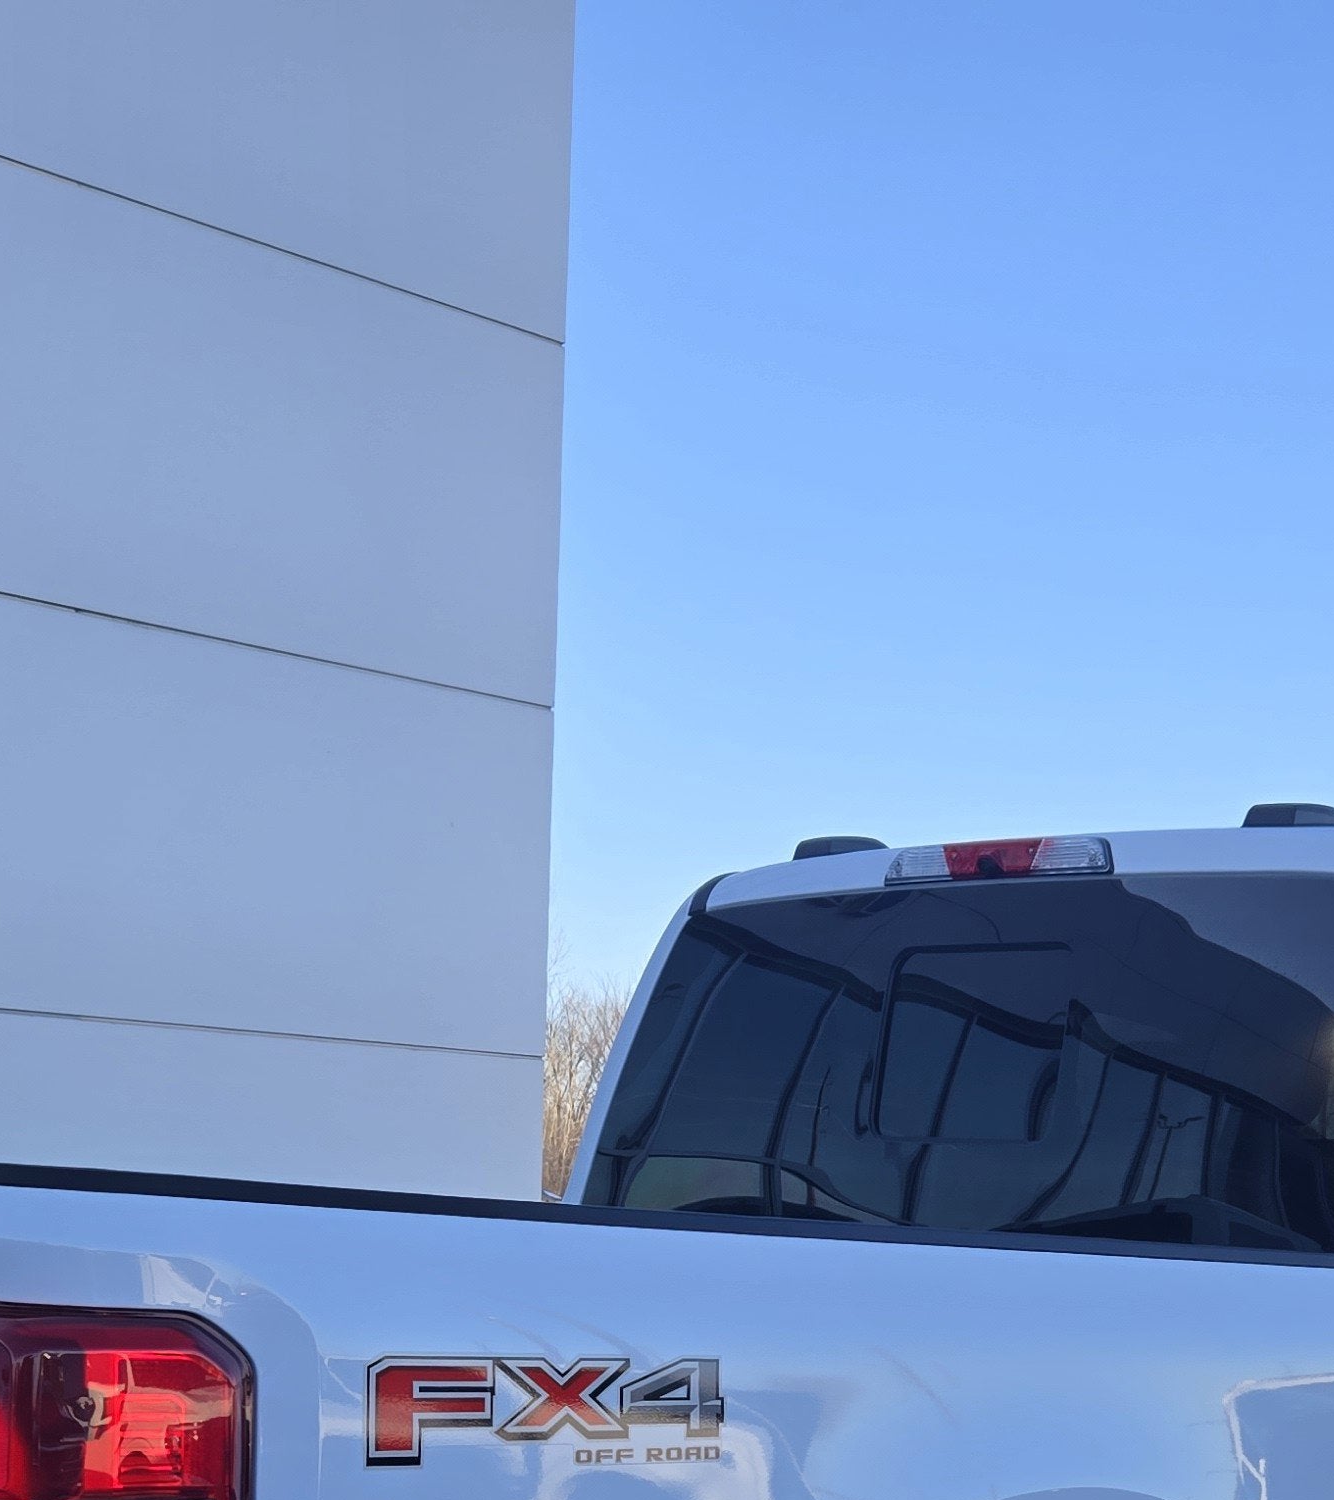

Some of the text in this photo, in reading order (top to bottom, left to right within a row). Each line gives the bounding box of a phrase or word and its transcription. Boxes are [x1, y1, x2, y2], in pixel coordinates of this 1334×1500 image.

[364, 1354, 725, 1468] FX4
[574, 1445, 721, 1464] OFF ROAD
